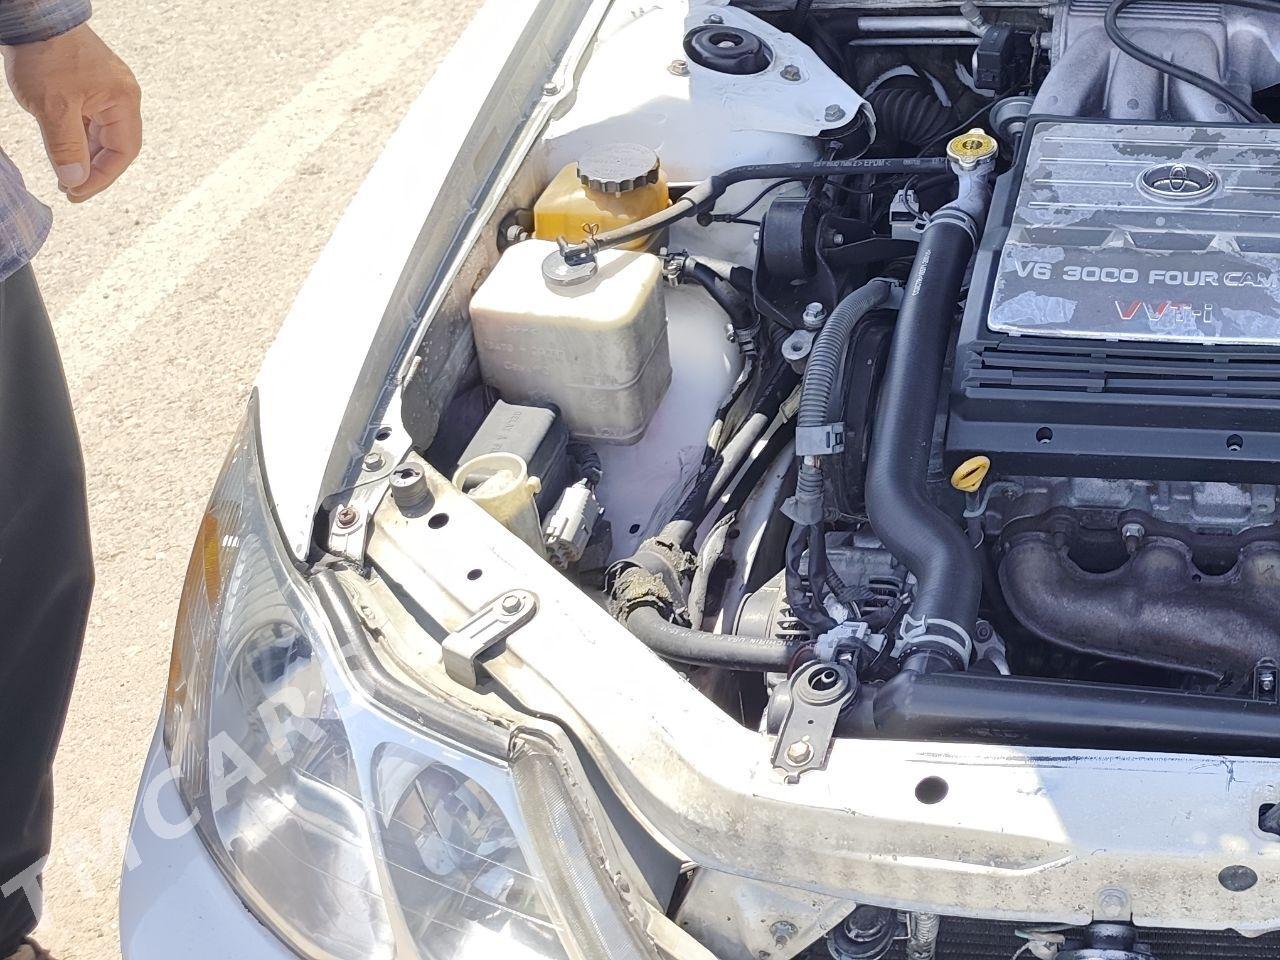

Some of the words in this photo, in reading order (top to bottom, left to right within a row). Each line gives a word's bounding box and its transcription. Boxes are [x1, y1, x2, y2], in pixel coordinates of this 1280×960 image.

[1013, 260, 1052, 280] V6
[1062, 266, 1139, 284] 3000
[1148, 269, 1219, 287] FOUR
[1223, 271, 1280, 288] CAM
[1114, 299, 1213, 324] VVT-i
